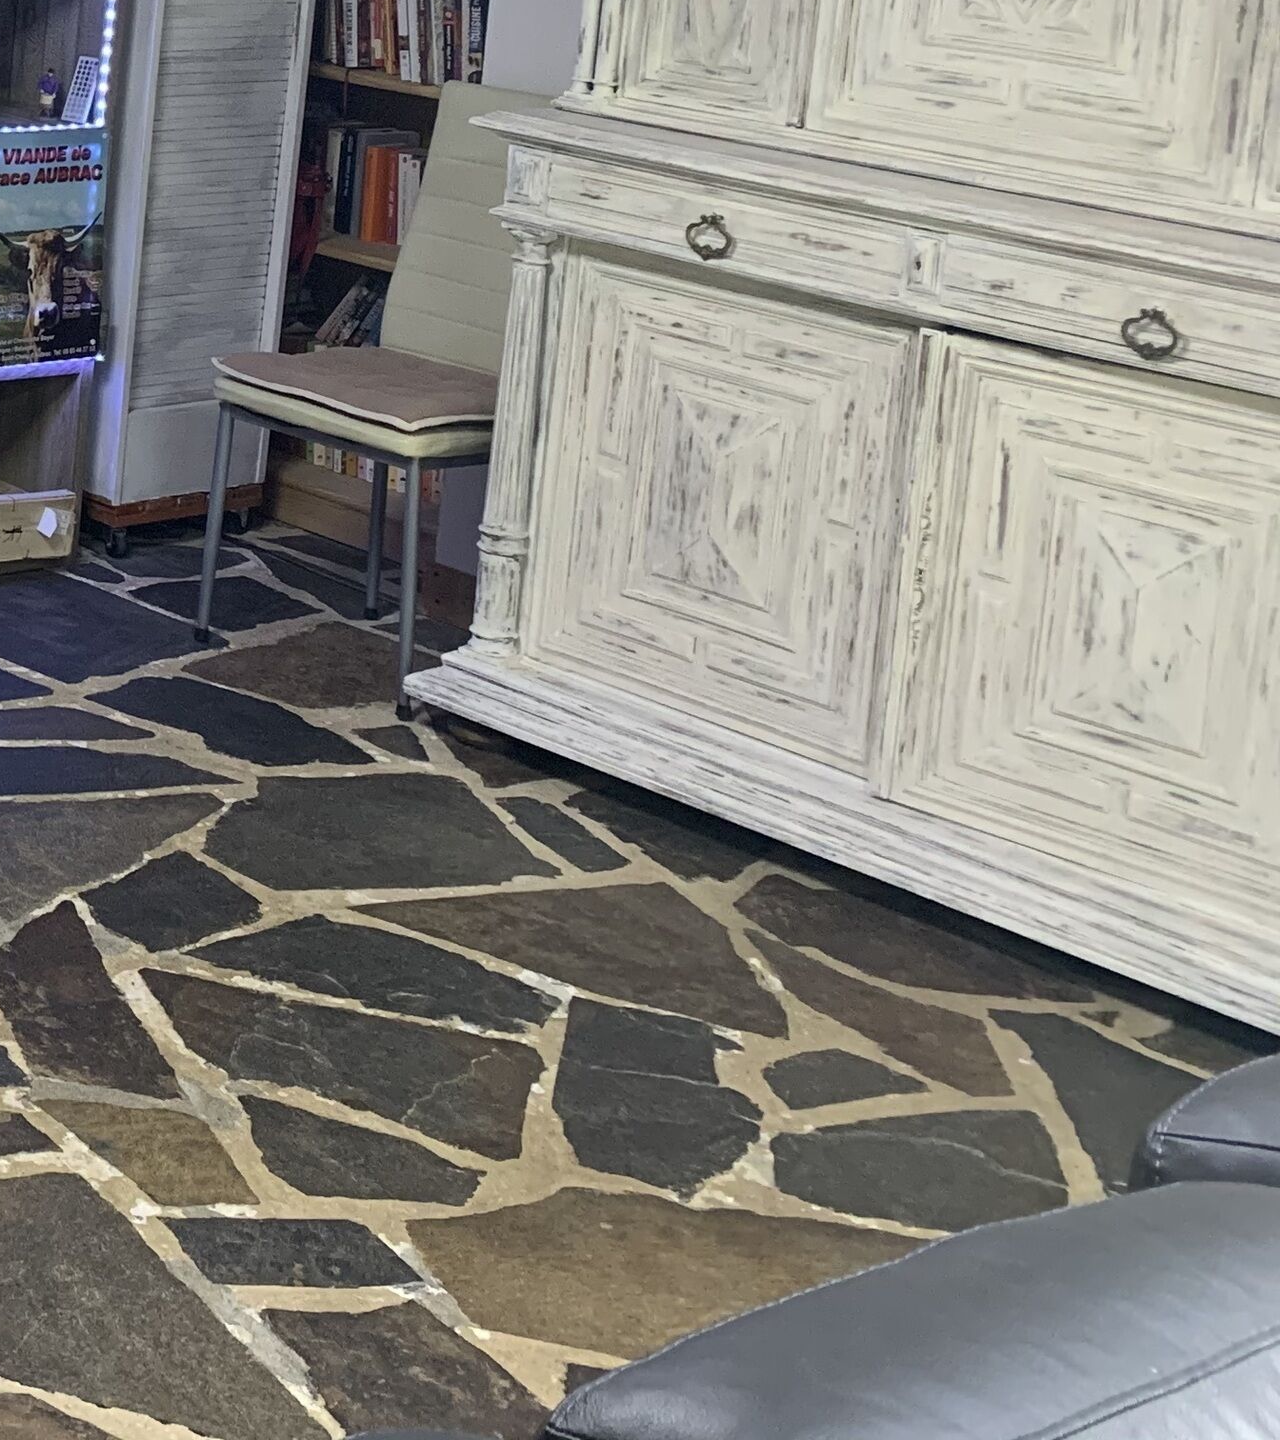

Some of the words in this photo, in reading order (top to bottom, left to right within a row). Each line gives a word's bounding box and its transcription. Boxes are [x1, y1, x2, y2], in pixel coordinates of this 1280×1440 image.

[470, 6, 482, 42] CUISINE
[3, 145, 68, 165] VIANDE
[71, 144, 92, 161] de
[33, 164, 103, 184] AUBRAC
